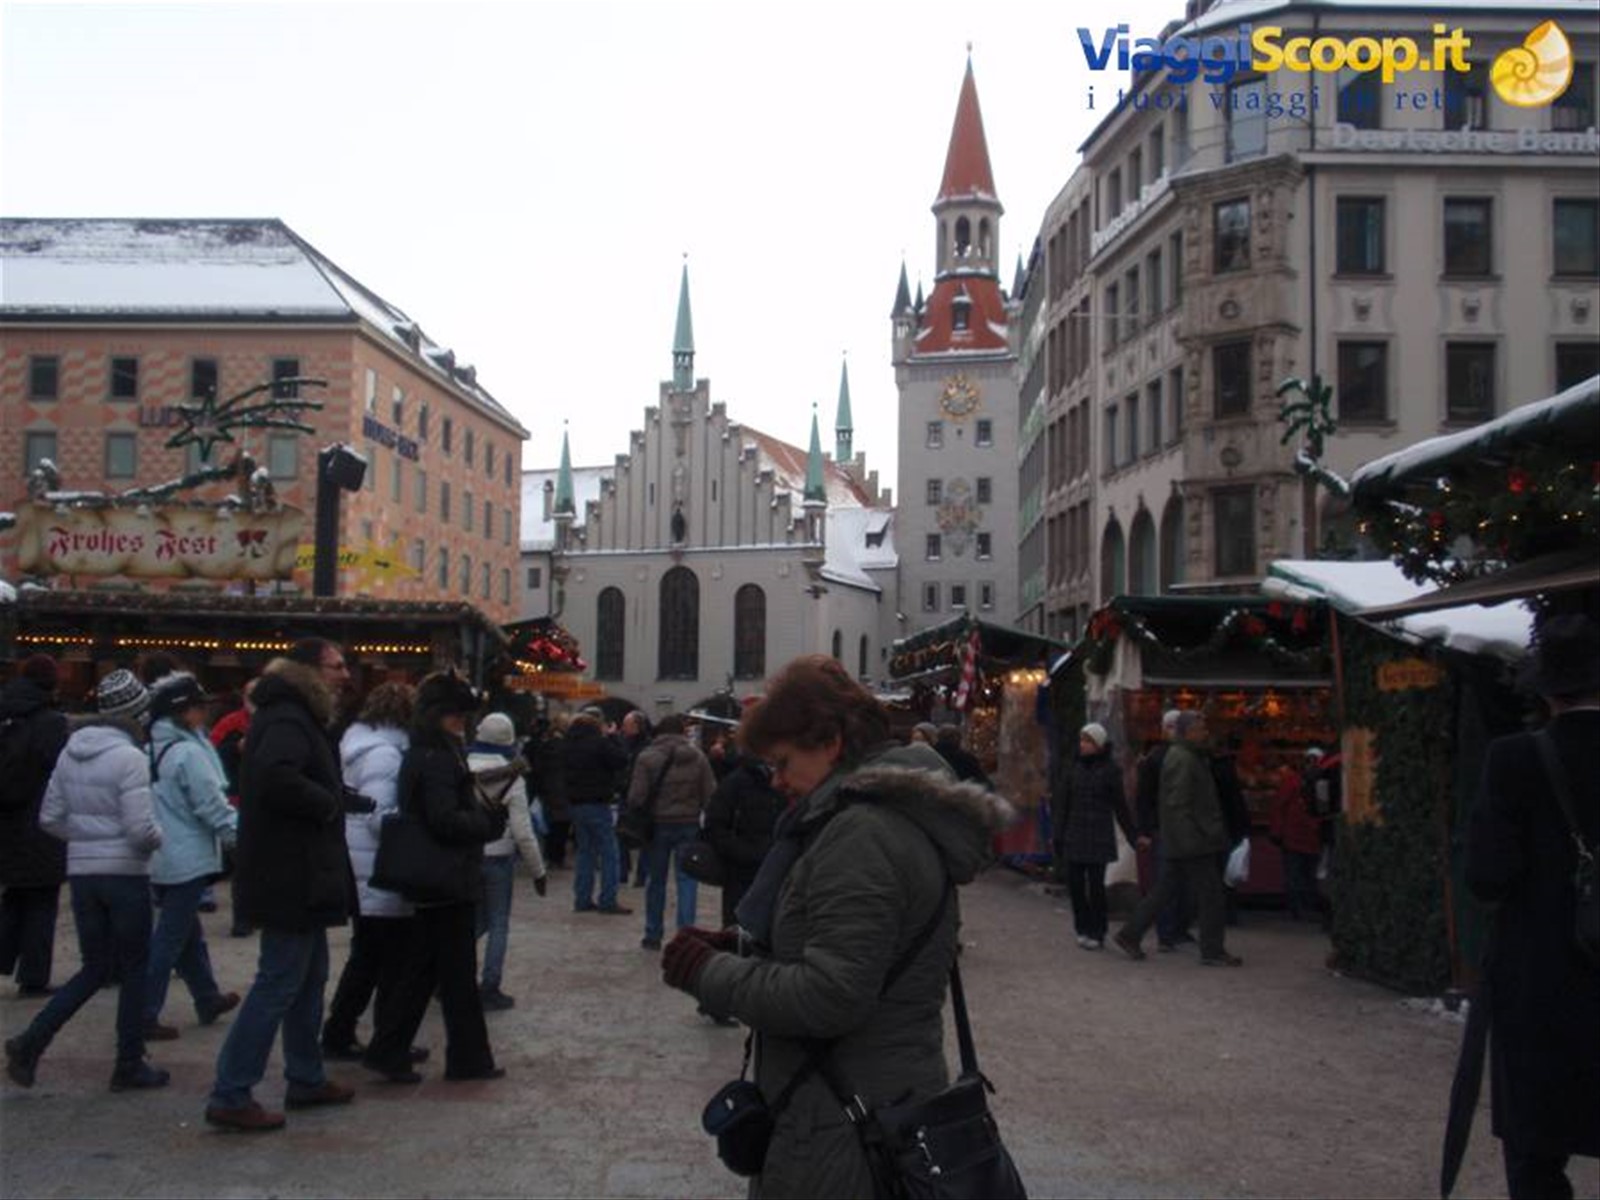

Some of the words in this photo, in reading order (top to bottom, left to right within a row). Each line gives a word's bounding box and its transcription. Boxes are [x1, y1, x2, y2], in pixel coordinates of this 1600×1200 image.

[1333, 123, 1504, 150] Deutsche
[48, 526, 143, 557] Frohes
[155, 529, 217, 560] Fest
